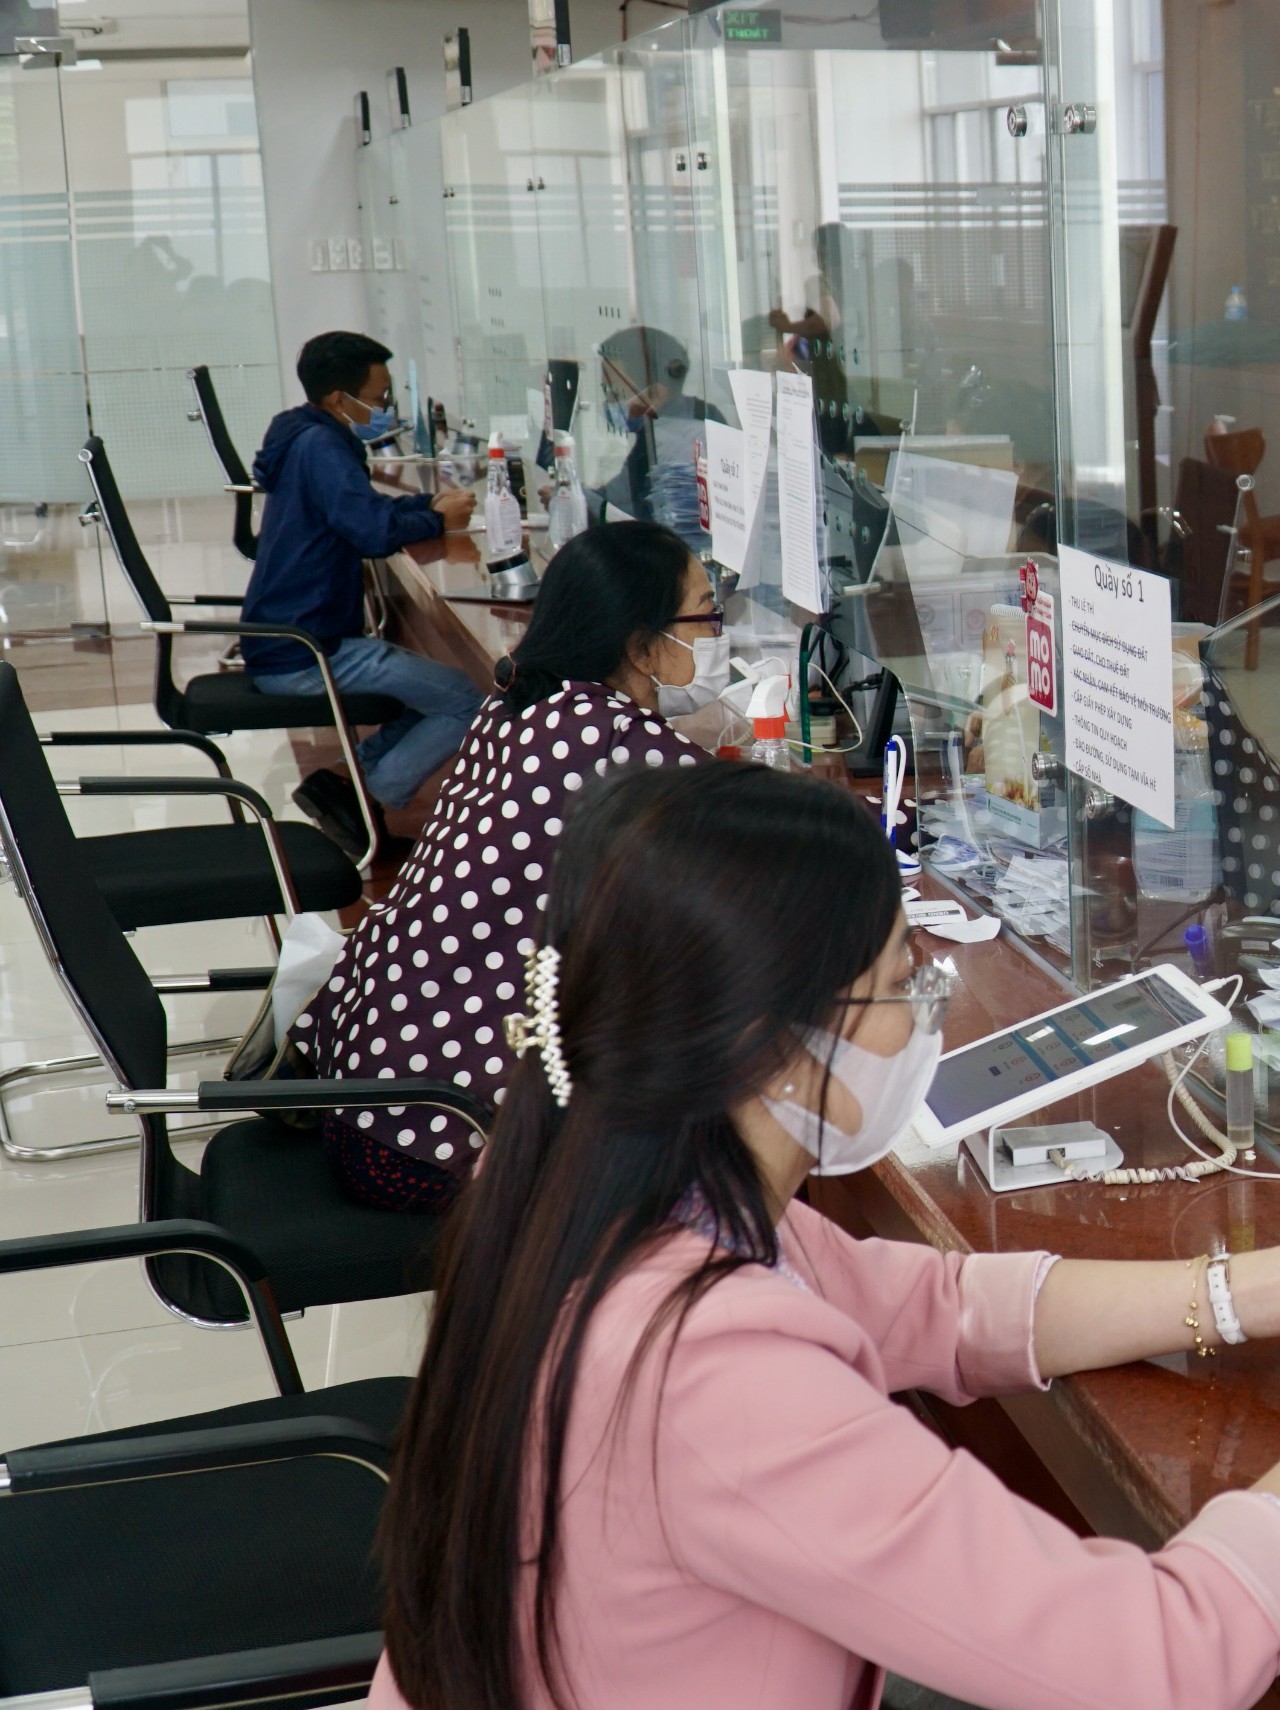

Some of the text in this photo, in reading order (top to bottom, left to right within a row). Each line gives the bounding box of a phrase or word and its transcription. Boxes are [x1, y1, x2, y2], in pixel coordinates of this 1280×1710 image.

[1094, 563, 1145, 603] Quầy số 1
[1071, 595, 1079, 609] THU
[1073, 688, 1132, 732] CẤP GIẤY PHÉP XÂY DỰNG
[1074, 714, 1090, 732] THÔNG
[1090, 723, 1098, 737] TIN
[1110, 734, 1127, 753] HOẠCH
[1075, 758, 1084, 775] CẤP
[1112, 758, 1127, 778] DỤNG
